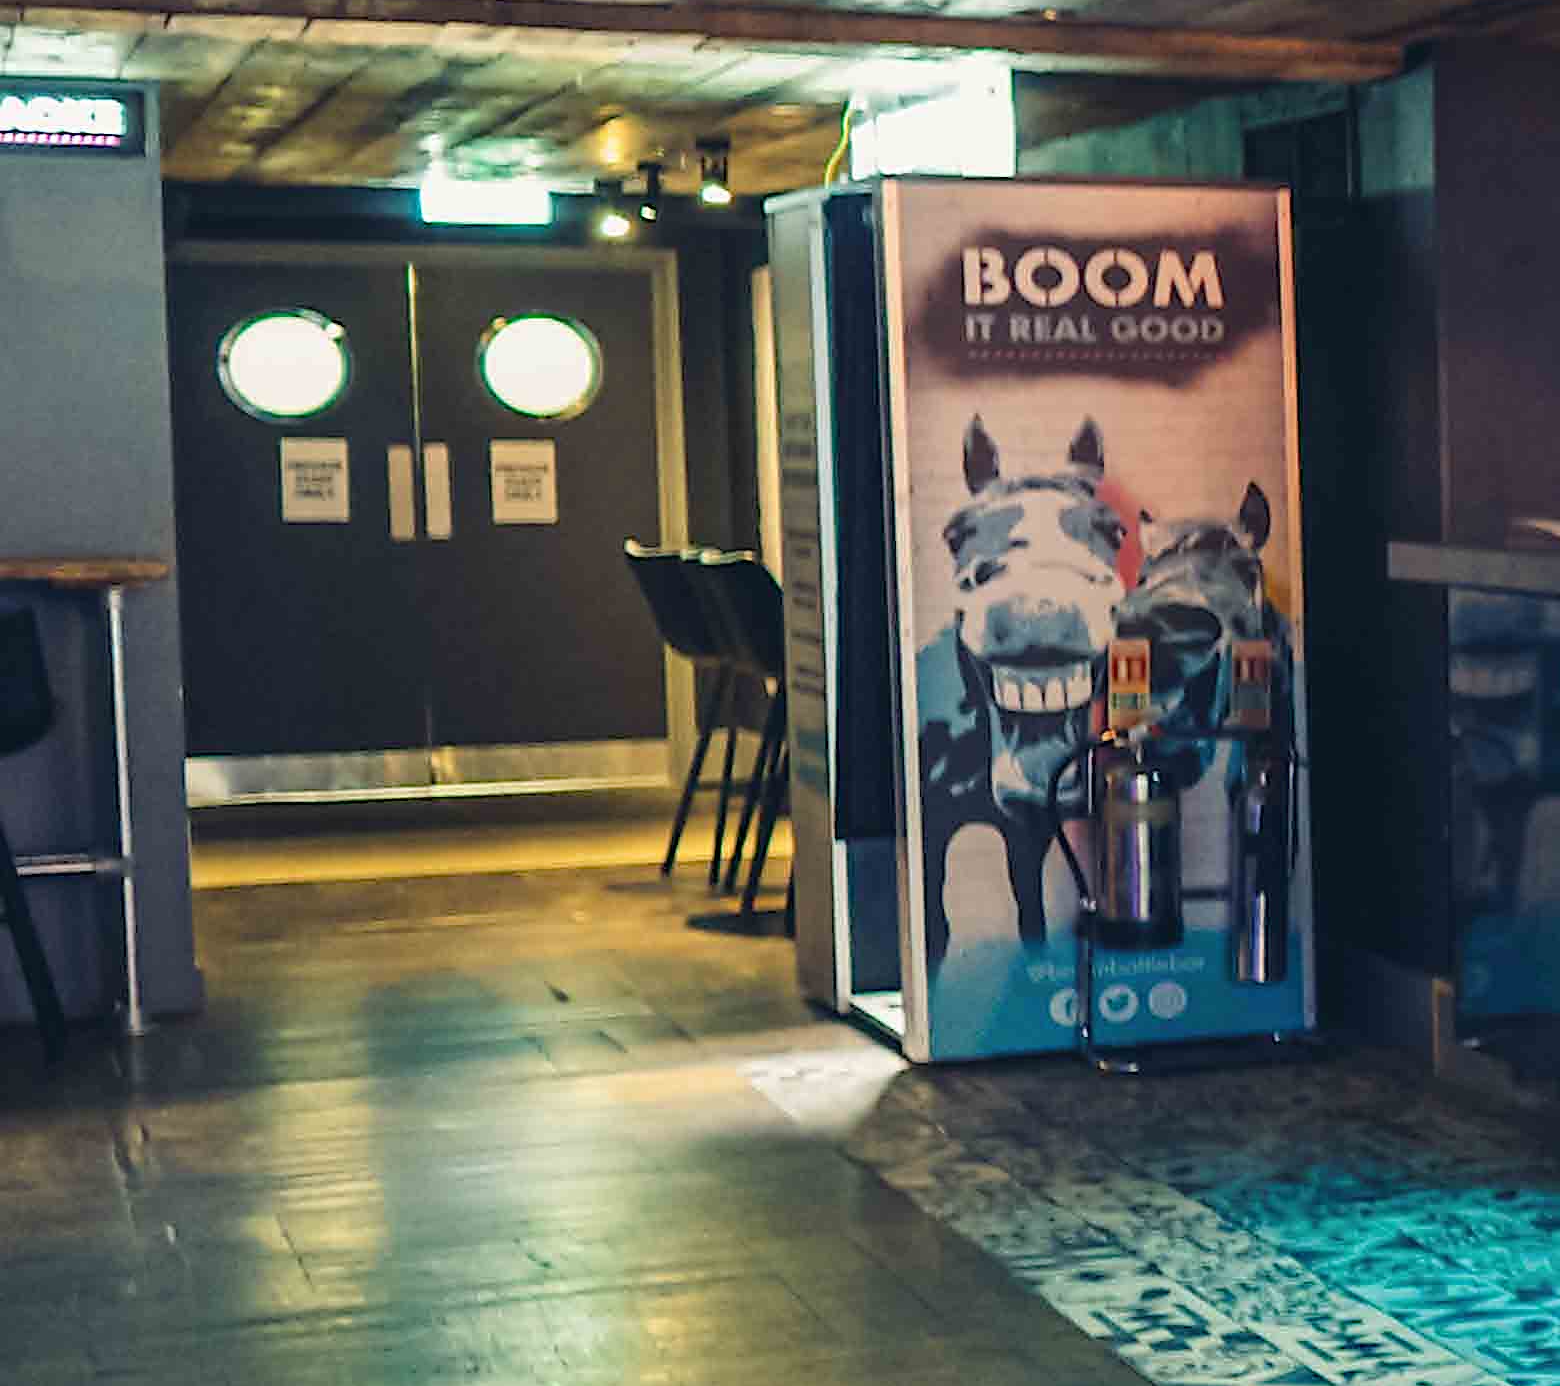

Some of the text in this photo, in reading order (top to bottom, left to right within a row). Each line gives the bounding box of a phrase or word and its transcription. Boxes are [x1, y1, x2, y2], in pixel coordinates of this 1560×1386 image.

[962, 247, 1224, 307] BOOM
[966, 315, 1224, 343] IT REAL GOOD
